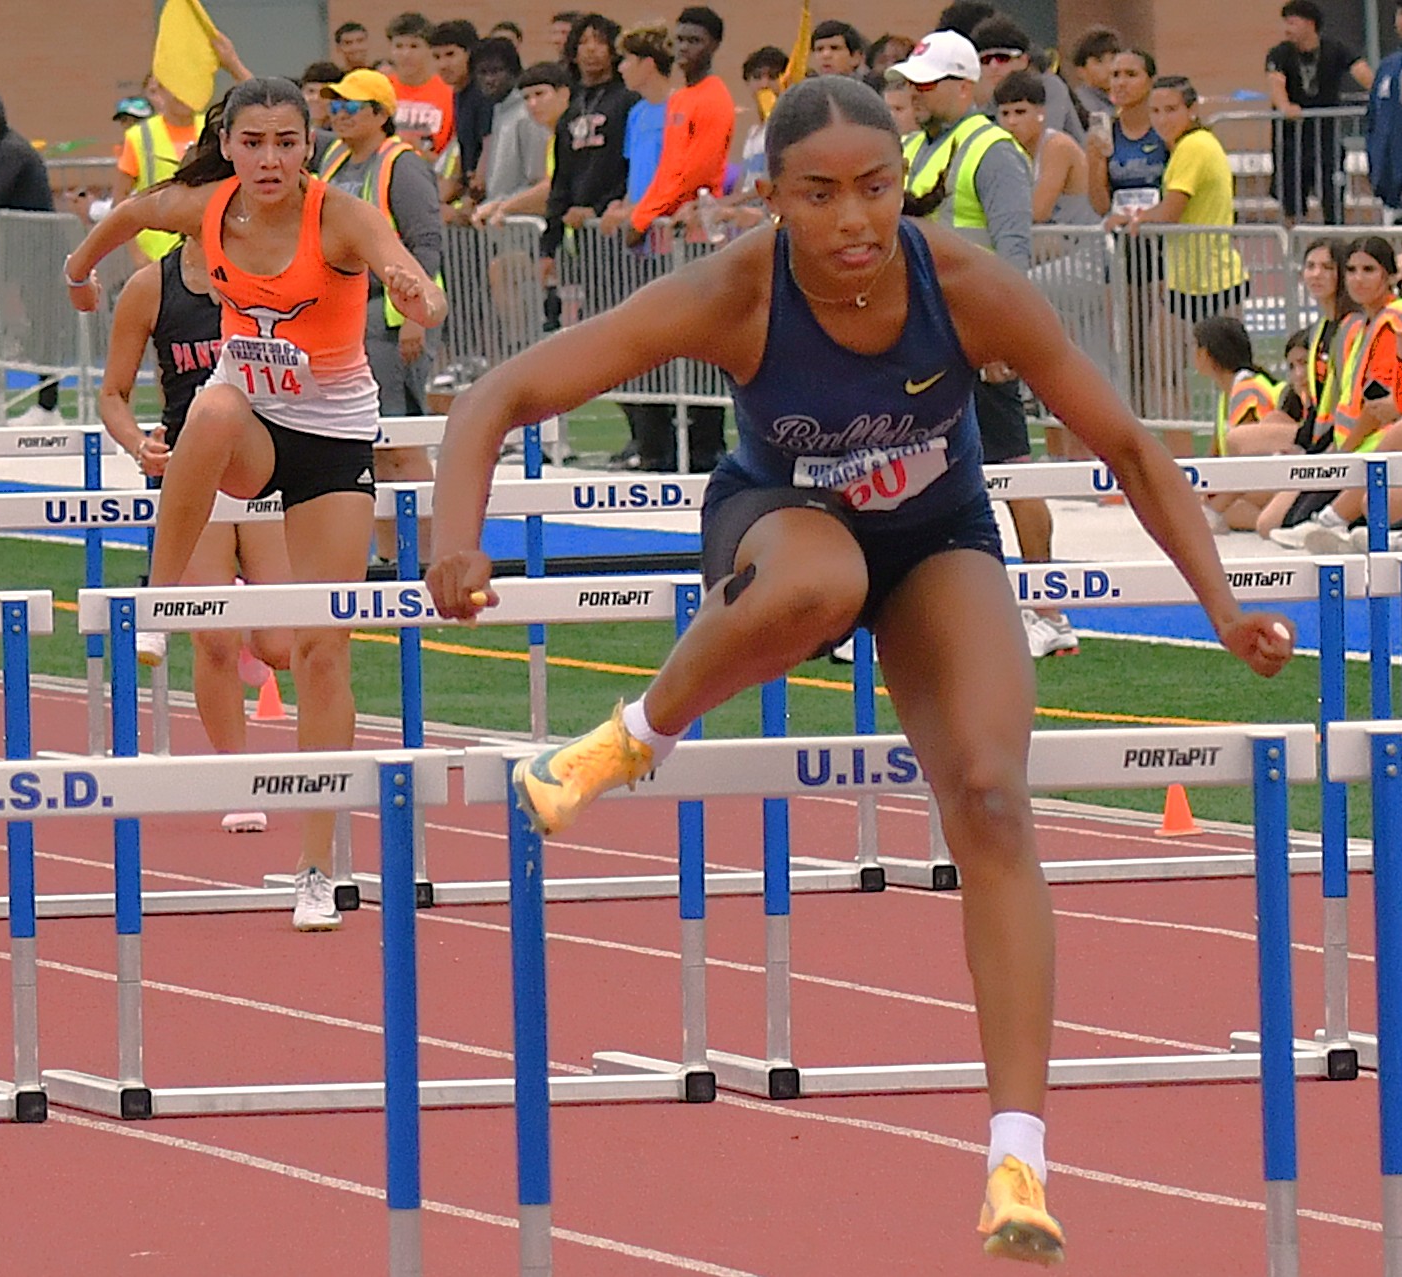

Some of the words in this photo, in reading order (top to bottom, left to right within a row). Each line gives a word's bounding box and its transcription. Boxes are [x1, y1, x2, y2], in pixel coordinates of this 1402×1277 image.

[231, 350, 262, 361] TRACK
[273, 354, 298, 365] FIELD
[240, 364, 301, 394] 114
[573, 483, 691, 509] U.I.S.D.
